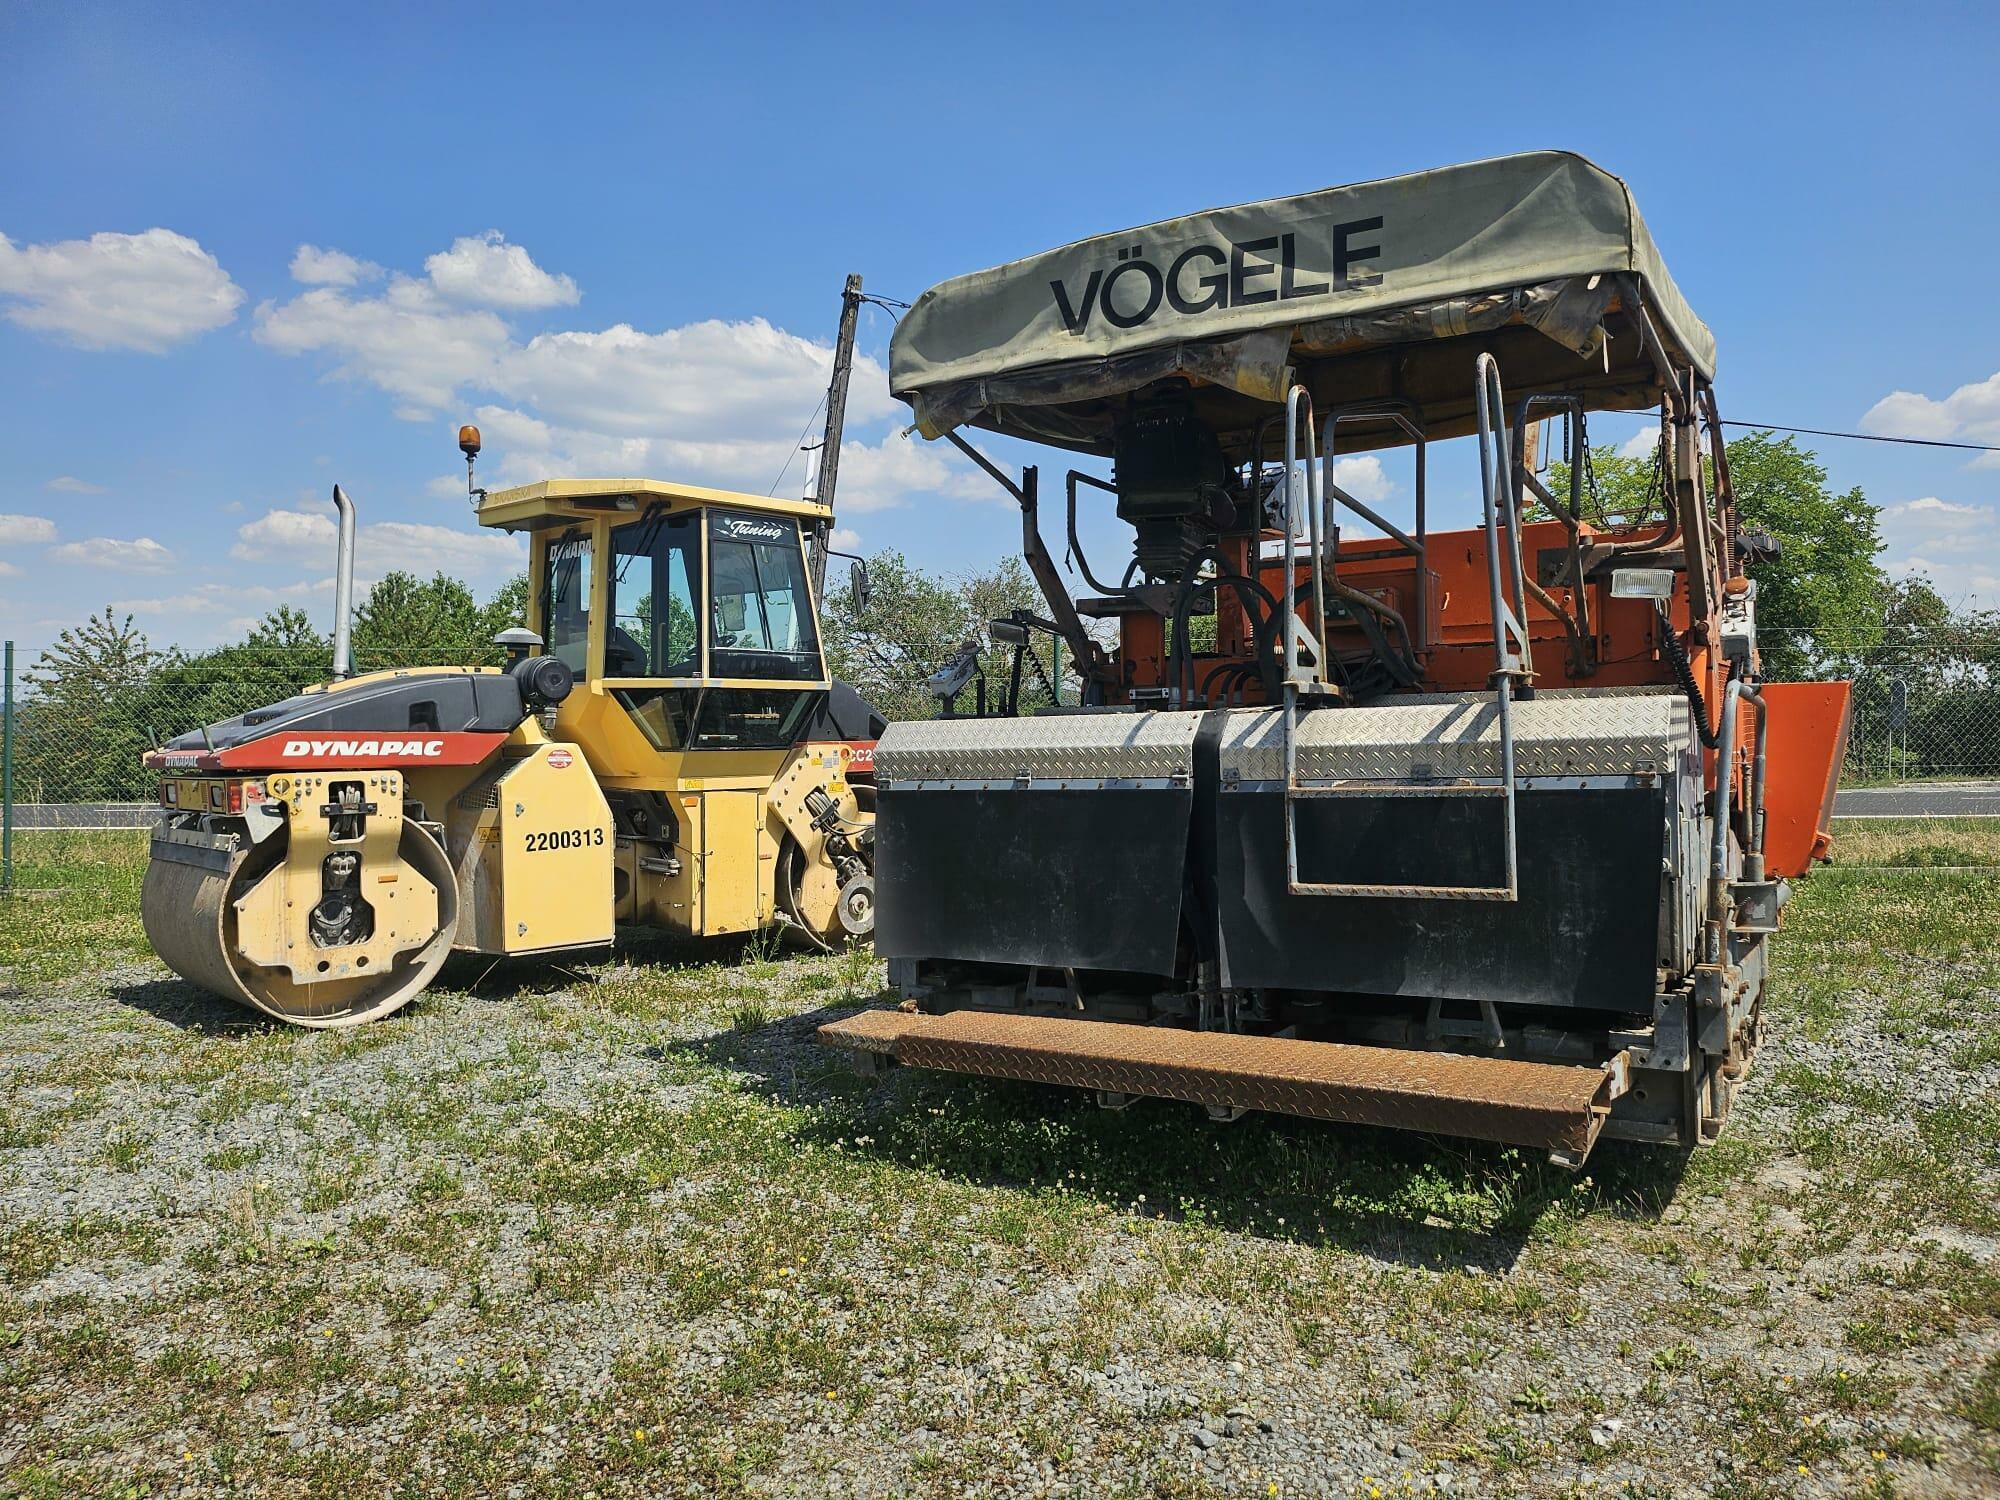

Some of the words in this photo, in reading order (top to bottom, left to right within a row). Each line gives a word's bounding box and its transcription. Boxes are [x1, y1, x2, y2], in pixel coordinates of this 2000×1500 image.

[1050, 216, 1383, 336] VÖGELE
[730, 520, 783, 540] Tuning
[549, 539, 592, 561] DYNAPA
[282, 741, 444, 757] DYNAPAC
[165, 755, 198, 767] DYNAPAC
[525, 828, 604, 852] 2200313
